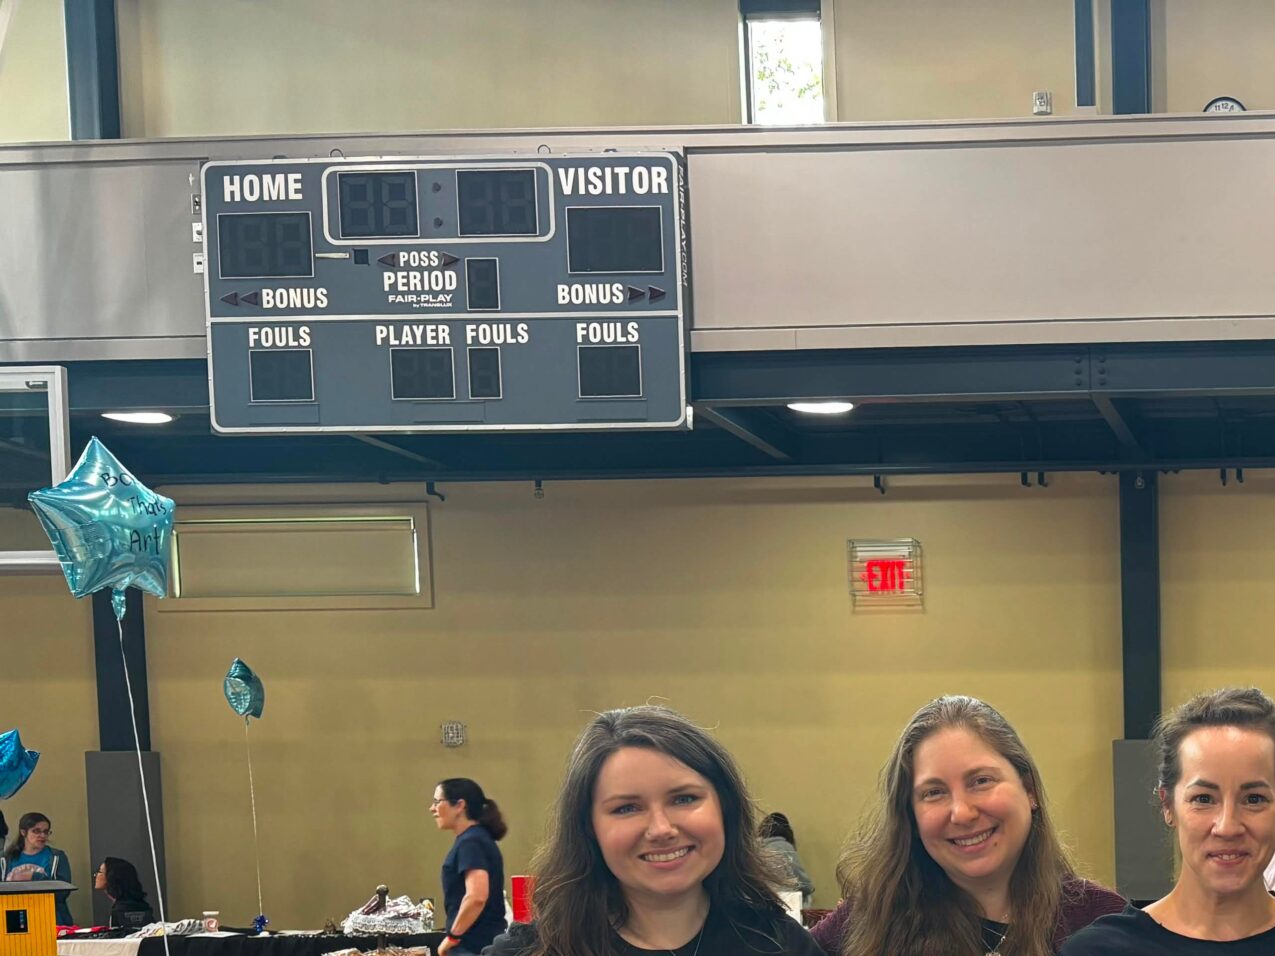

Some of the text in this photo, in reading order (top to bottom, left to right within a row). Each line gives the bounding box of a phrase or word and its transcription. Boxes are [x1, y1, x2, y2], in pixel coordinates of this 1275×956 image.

[222, 173, 303, 202] HOME
[557, 165, 669, 195] VISITOR
[678, 164, 689, 287] FAIR-PLAY.COM
[399, 250, 439, 267] POSS
[383, 270, 457, 292] PERIOD
[261, 288, 328, 309] BONUS
[556, 283, 624, 305] BONUS
[248, 326, 311, 348] FOULS
[375, 322, 529, 346] PLAYER FOULS
[576, 321, 640, 343] FOULS
[129, 527, 162, 555] Art
[866, 559, 905, 592] EXIT
